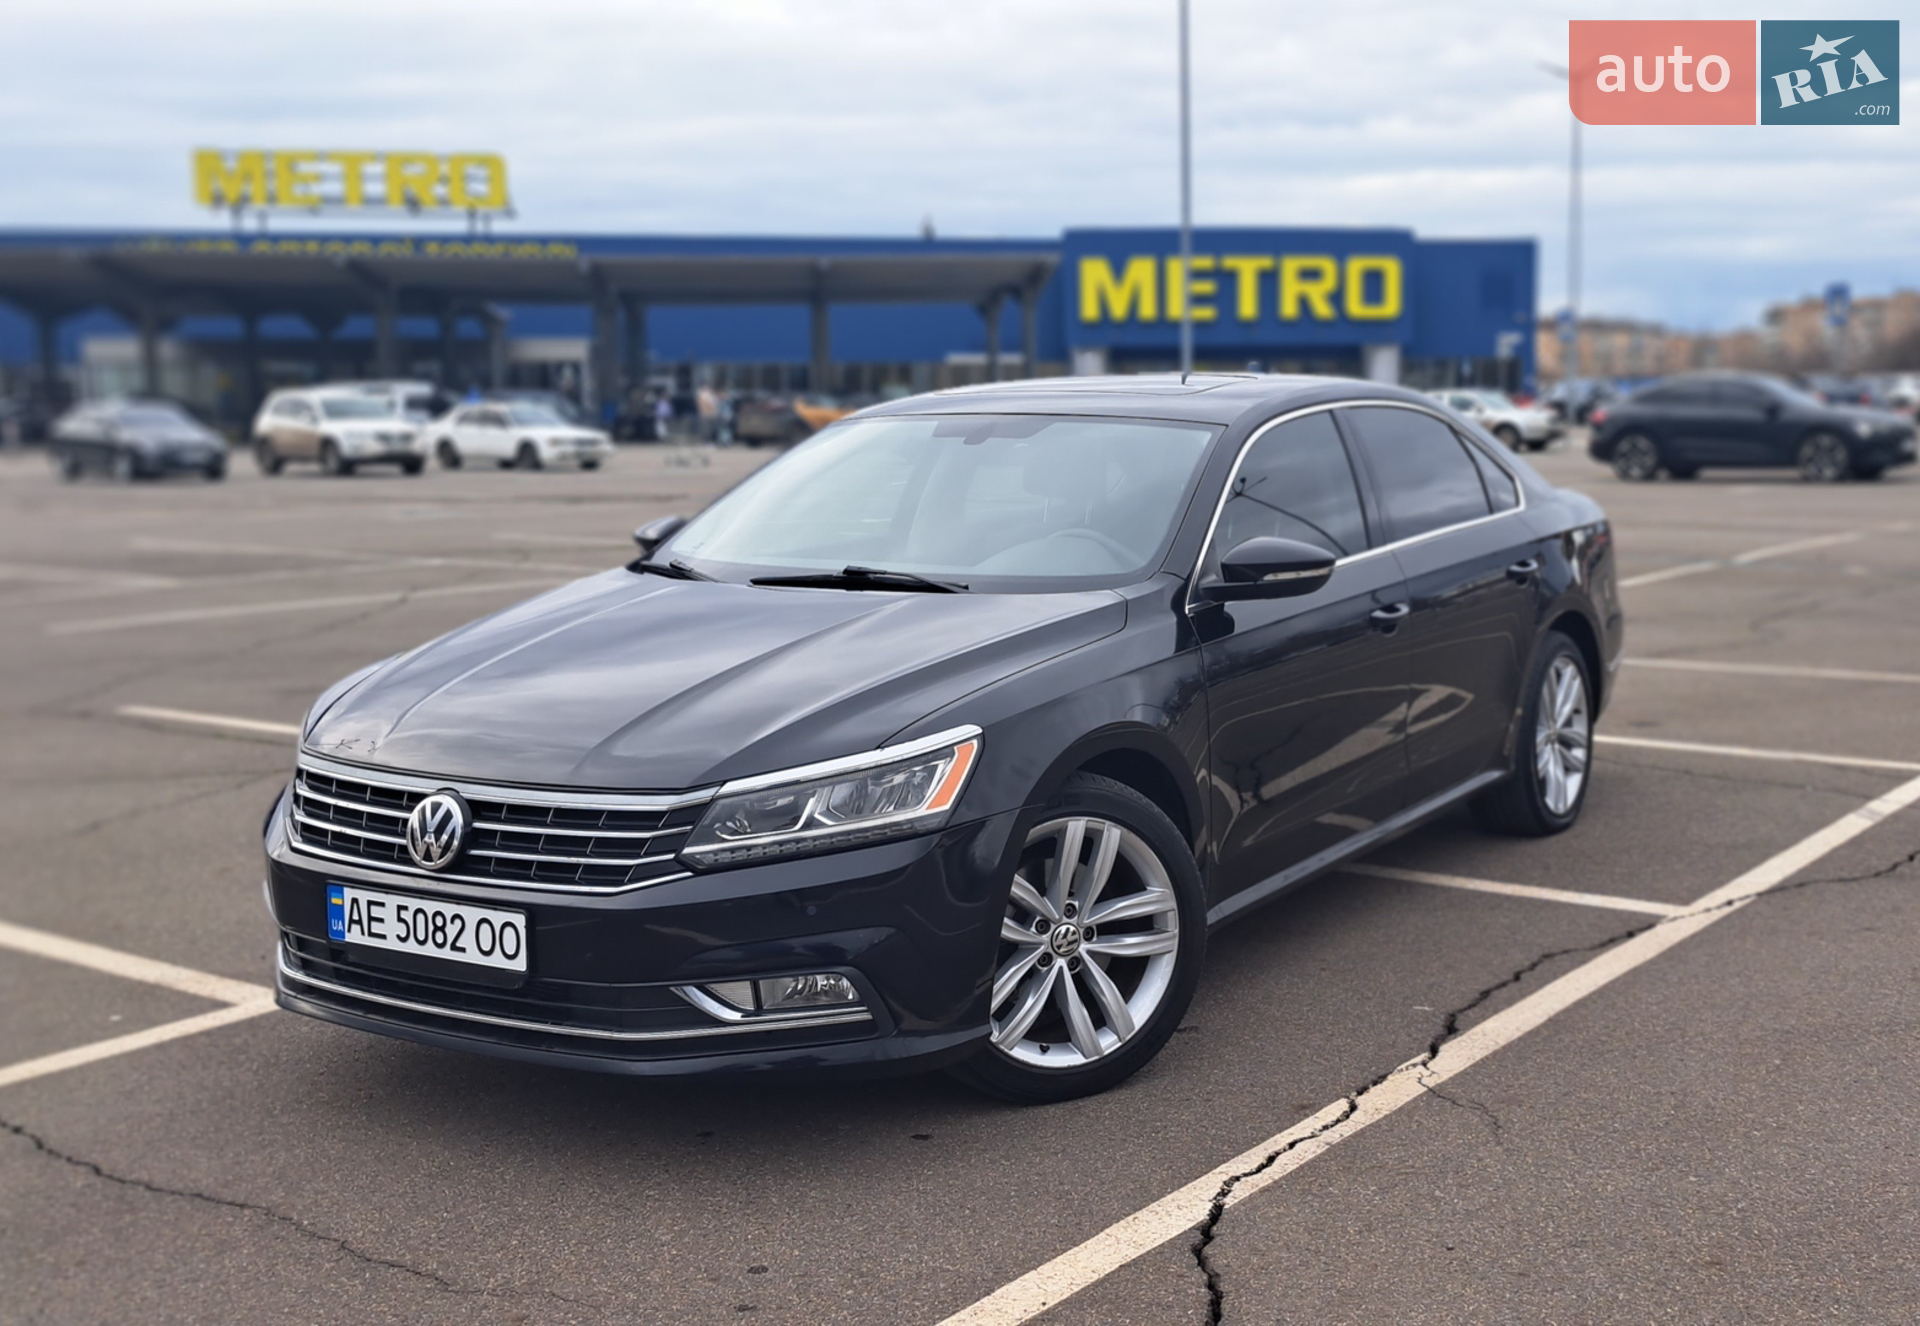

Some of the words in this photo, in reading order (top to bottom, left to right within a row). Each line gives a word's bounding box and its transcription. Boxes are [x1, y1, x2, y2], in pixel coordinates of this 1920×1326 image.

[195, 151, 506, 209] METRO
[1079, 255, 1402, 322] METRO
[331, 918, 344, 932] UA
[347, 897, 387, 940] AE
[396, 904, 467, 954] 5082
